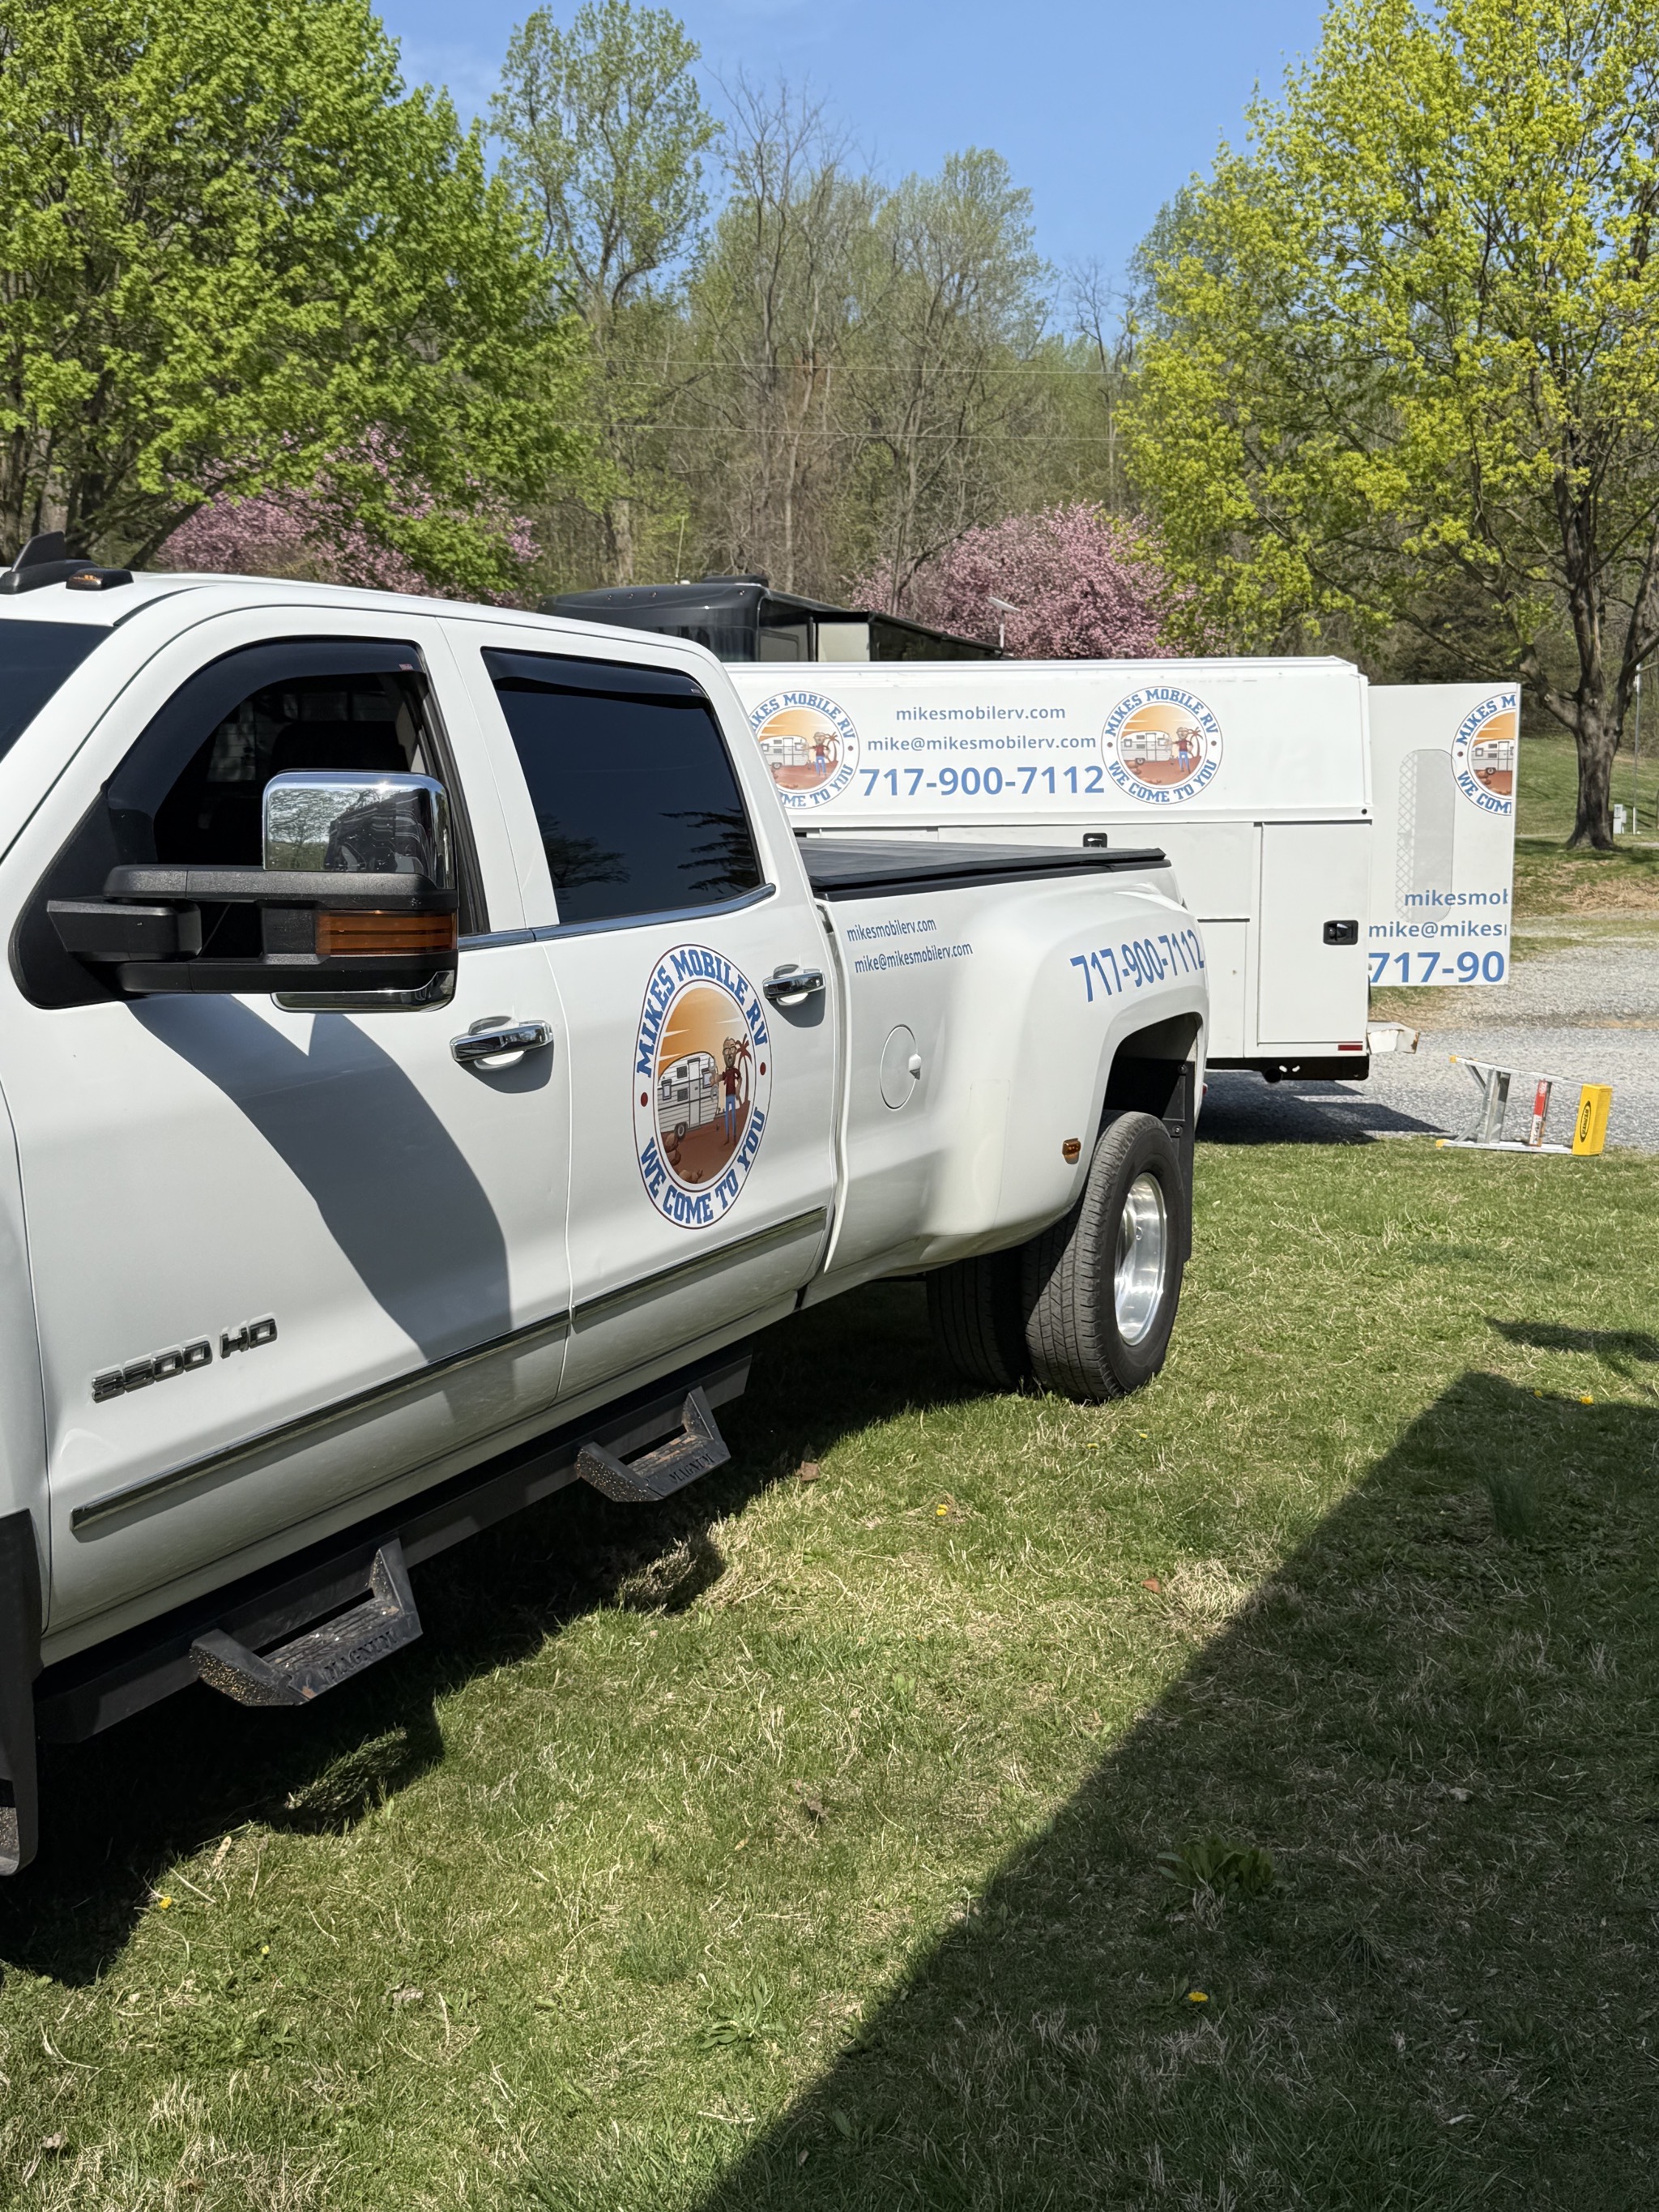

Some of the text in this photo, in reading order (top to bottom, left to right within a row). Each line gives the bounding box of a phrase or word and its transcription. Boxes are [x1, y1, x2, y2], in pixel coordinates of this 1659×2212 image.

[750, 693, 855, 739] IKES MOBILE RV
[895, 705, 1066, 721] mikesmobilerv.com
[1105, 688, 1218, 737] MIKES MOBILE RV
[1456, 700, 1498, 746] MIKES
[867, 735, 1097, 752] mike@mikesmobilerv.com
[780, 764, 854, 807] ME TO YOU
[859, 766, 1104, 796] 717-900-7112
[1108, 759, 1217, 803] WE COME TO YOU
[1457, 771, 1512, 813] WE COM
[847, 916, 936, 942] mikesmobilerv.com
[1369, 920, 1508, 938] mike@mikes
[855, 942, 973, 973] mike@mikesmobilerv.com
[1069, 929, 1205, 1002] 717-900-7112
[1368, 950, 1505, 983] 717-90
[637, 949, 768, 1078] MIKES MOBILE RV
[641, 1106, 766, 1224] WE COME TO YOU
[220, 1317, 278, 1359] HD
[322, 1630, 398, 1684] MAGNUM
